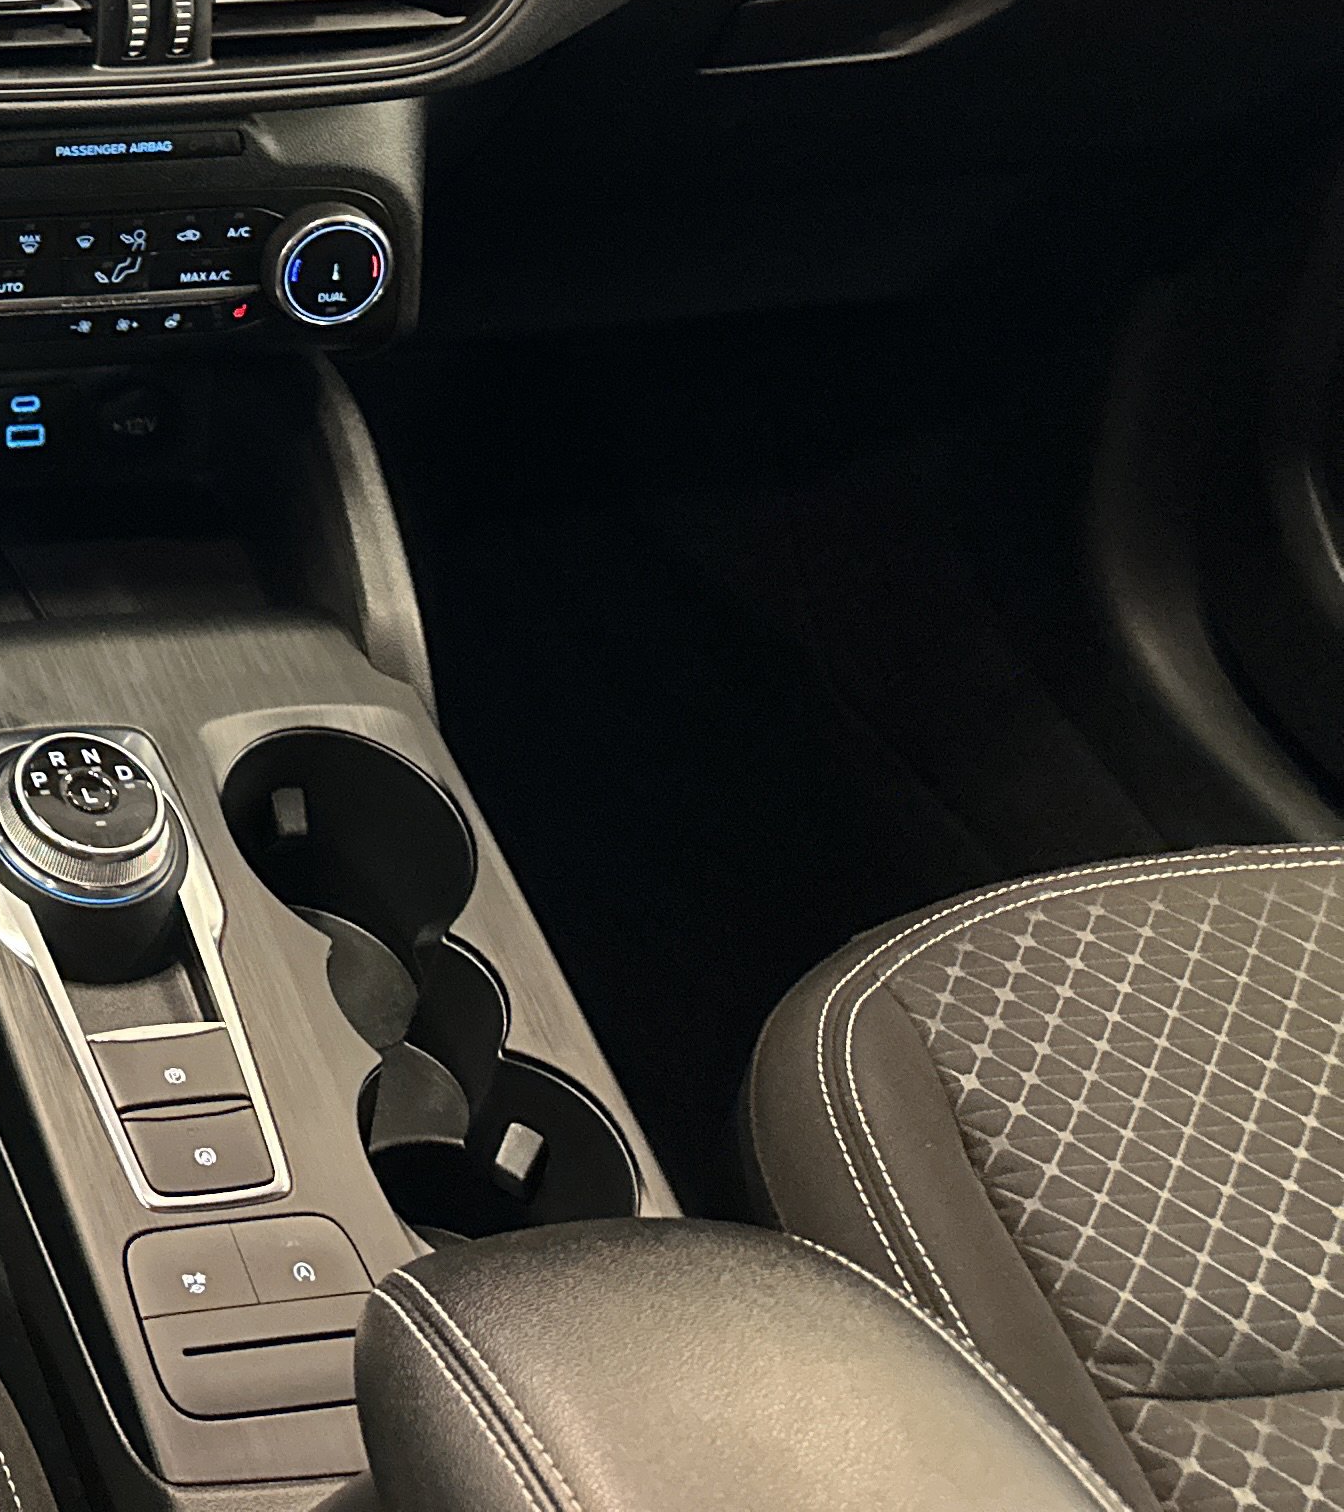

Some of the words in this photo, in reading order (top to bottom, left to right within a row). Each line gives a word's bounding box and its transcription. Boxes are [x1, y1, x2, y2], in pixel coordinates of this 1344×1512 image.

[55, 144, 126, 157] PASSENGER
[129, 141, 174, 153] AIRBAG
[227, 227, 252, 237] A/C
[180, 272, 207, 282] MAX
[208, 270, 232, 281] A/C
[318, 292, 347, 303] DUAL
[30, 771, 48, 788] P
[48, 751, 67, 767] R
[81, 748, 101, 764] N
[114, 765, 133, 780] D
[81, 788, 98, 804] L
